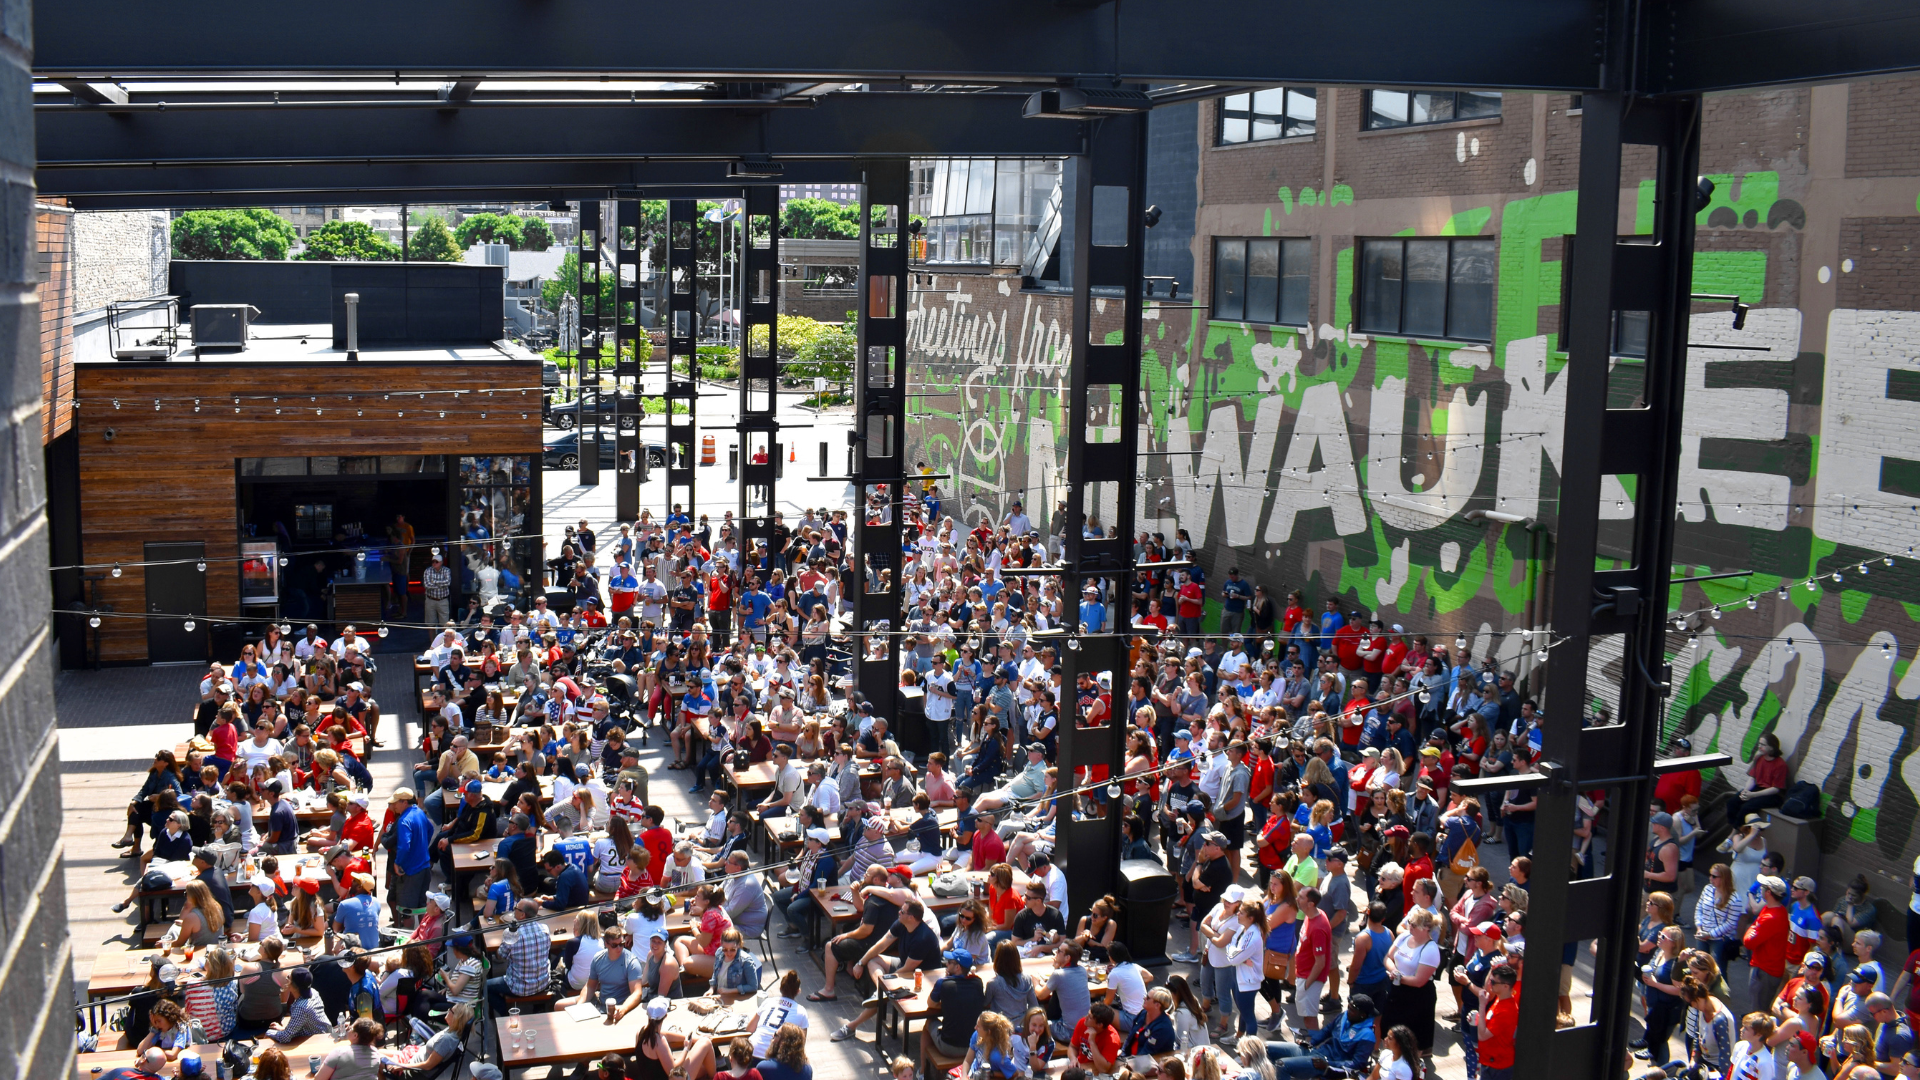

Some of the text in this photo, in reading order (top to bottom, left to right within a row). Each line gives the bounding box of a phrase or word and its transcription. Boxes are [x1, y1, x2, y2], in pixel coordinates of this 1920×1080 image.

[905, 280, 1008, 409] reetings
[920, 545, 935, 553] USA
[657, 840, 669, 863] 8
[763, 1006, 790, 1030] 13
